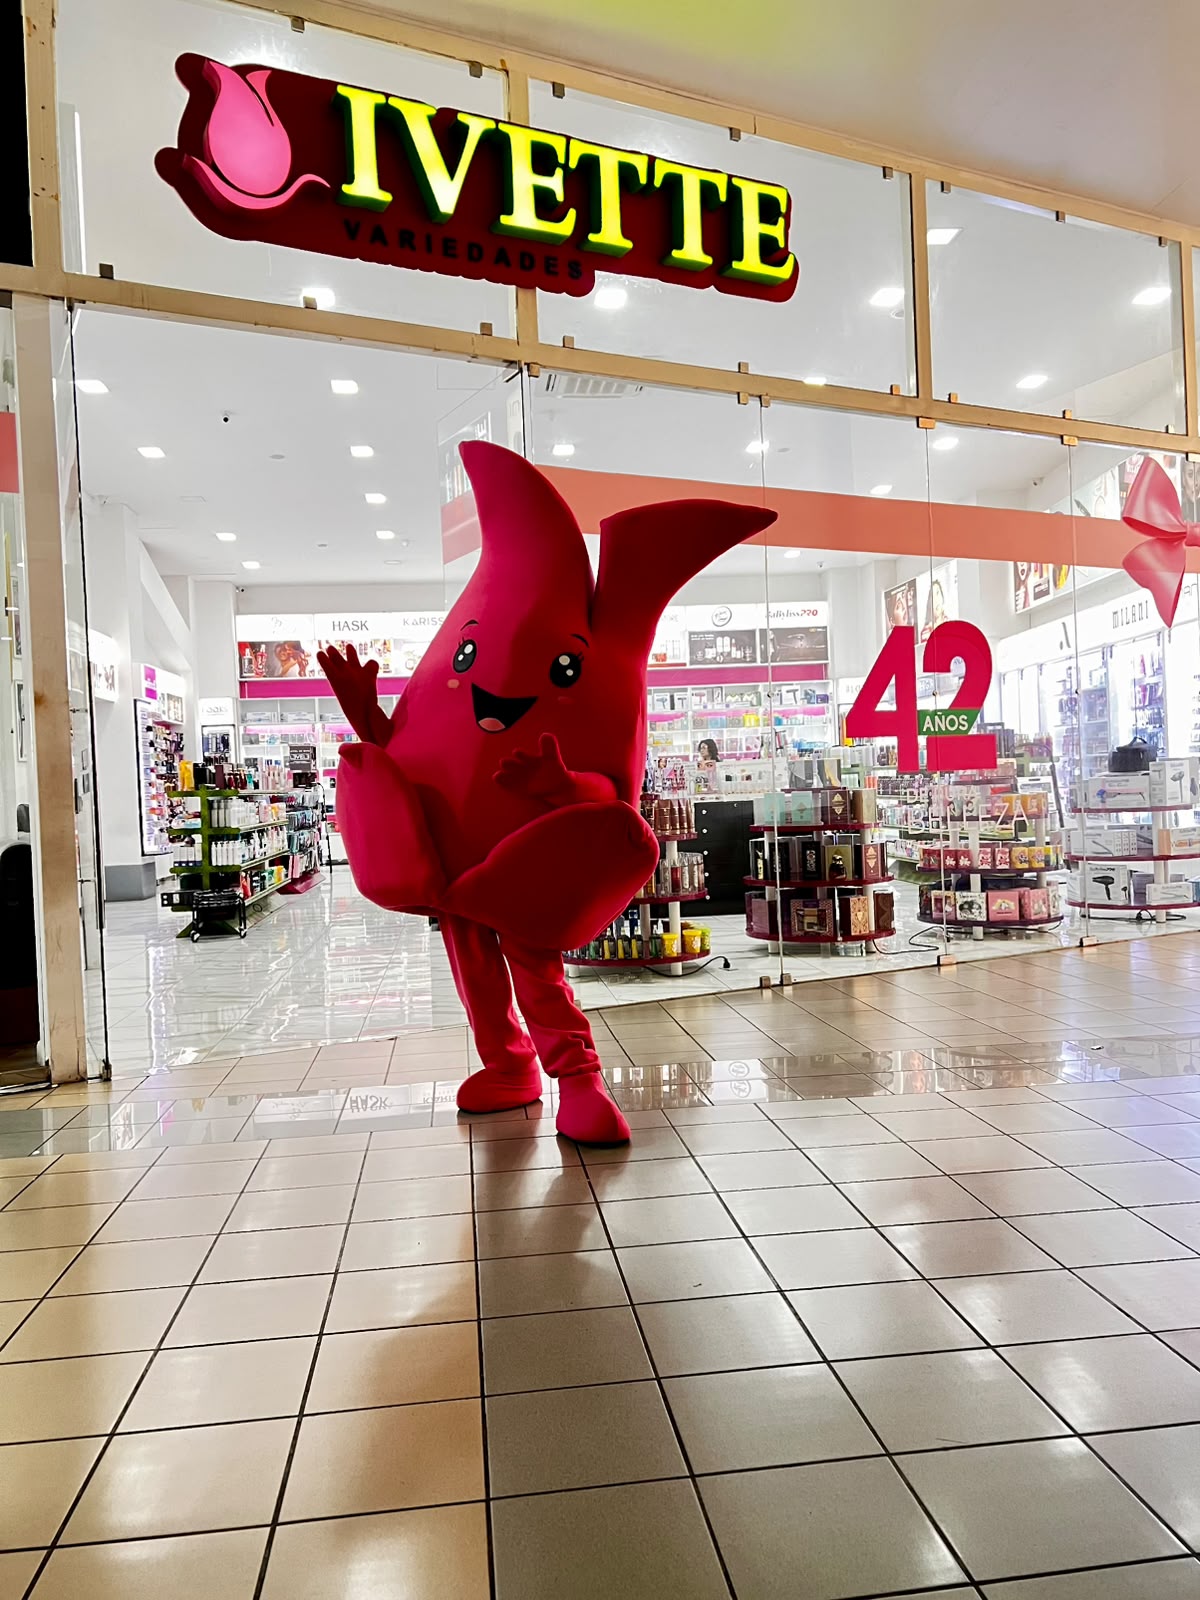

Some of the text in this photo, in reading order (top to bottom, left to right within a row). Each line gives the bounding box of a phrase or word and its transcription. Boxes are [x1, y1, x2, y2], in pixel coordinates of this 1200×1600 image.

[334, 84, 796, 284] IVETTE
[344, 219, 584, 280] VARIEDADES
[332, 620, 369, 632] HASK
[845, 620, 997, 775] 42
[922, 711, 969, 733] AÑOS
[908, 799, 1030, 835] BELLEZA
